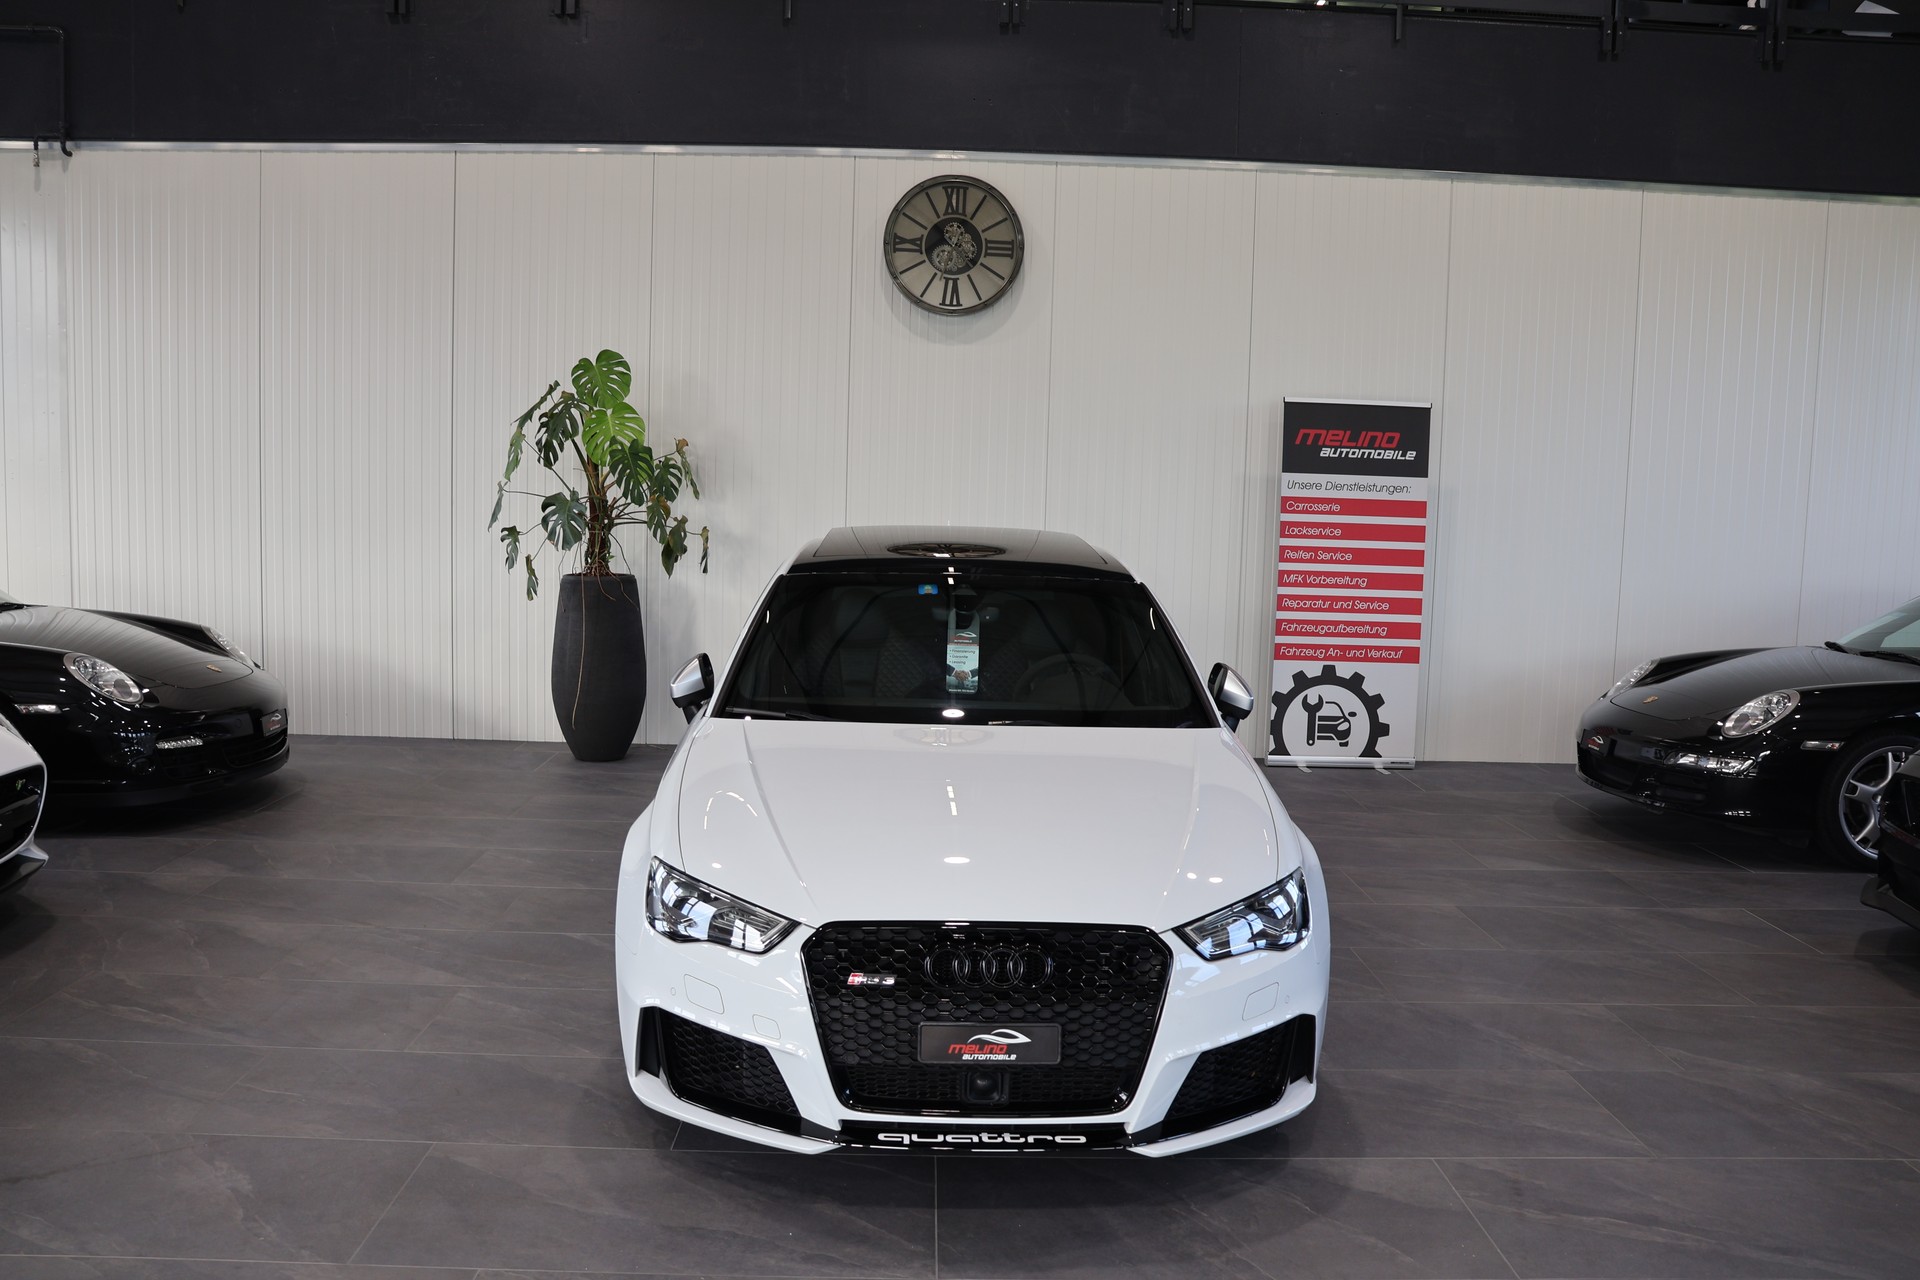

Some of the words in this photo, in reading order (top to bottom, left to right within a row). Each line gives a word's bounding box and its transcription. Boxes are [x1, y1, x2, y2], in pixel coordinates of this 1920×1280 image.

[942, 186, 969, 217] XII
[893, 232, 924, 255] IX
[984, 238, 1014, 259] III
[1286, 479, 1323, 491] Unsere
[1324, 480, 1412, 496] Dienstleistungen:
[1286, 501, 1341, 512] Carrosserie
[1284, 525, 1342, 536] Lackservice
[1283, 549, 1315, 560] Reifen
[1316, 550, 1353, 561] Service
[1282, 574, 1305, 583] MFK
[1305, 575, 1368, 587] Vorbereitung
[1281, 598, 1331, 609] Reparatur
[1332, 600, 1352, 609] und
[1353, 600, 1390, 611] Service
[1280, 622, 1388, 636] Fahrzeugaufbereitung
[1279, 646, 1326, 659] Fahrzeug
[1326, 647, 1344, 657] An-
[1345, 648, 1366, 658] und
[1366, 649, 1404, 659] Verkauf
[877, 1132, 1087, 1145] quattro
